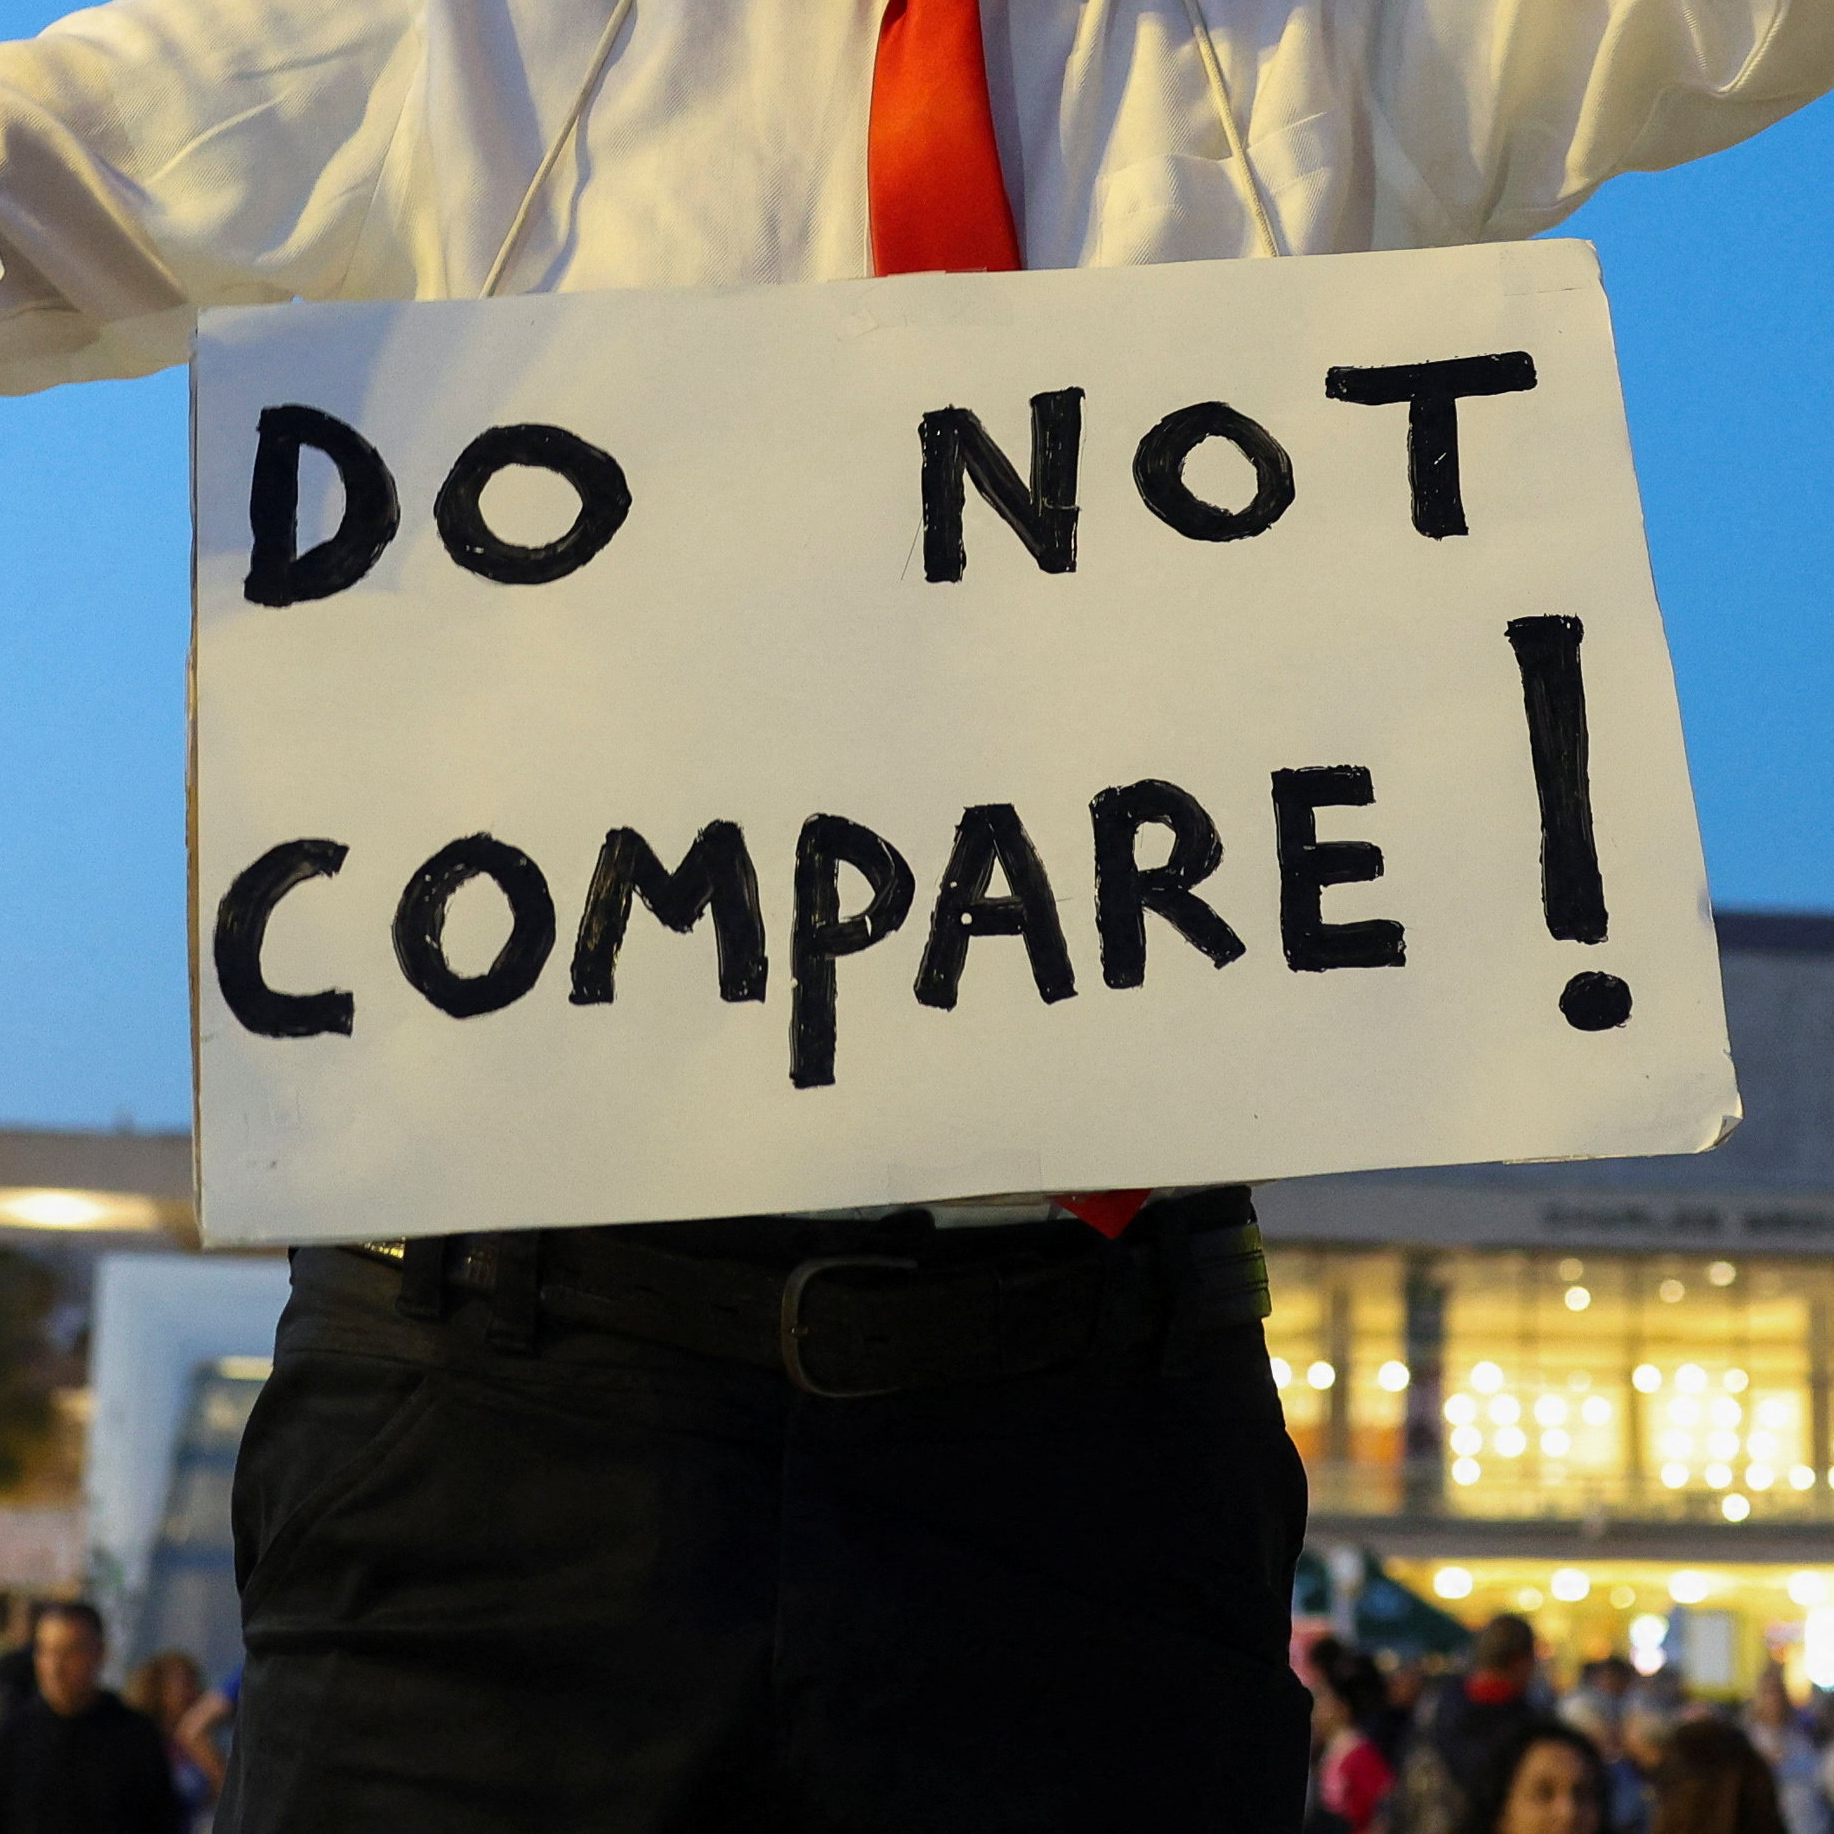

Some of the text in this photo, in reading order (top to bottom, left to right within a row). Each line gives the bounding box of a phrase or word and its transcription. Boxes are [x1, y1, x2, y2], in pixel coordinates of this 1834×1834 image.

[243, 350, 1539, 608] DO NOT
[213, 613, 1635, 1090] COMPARE!
